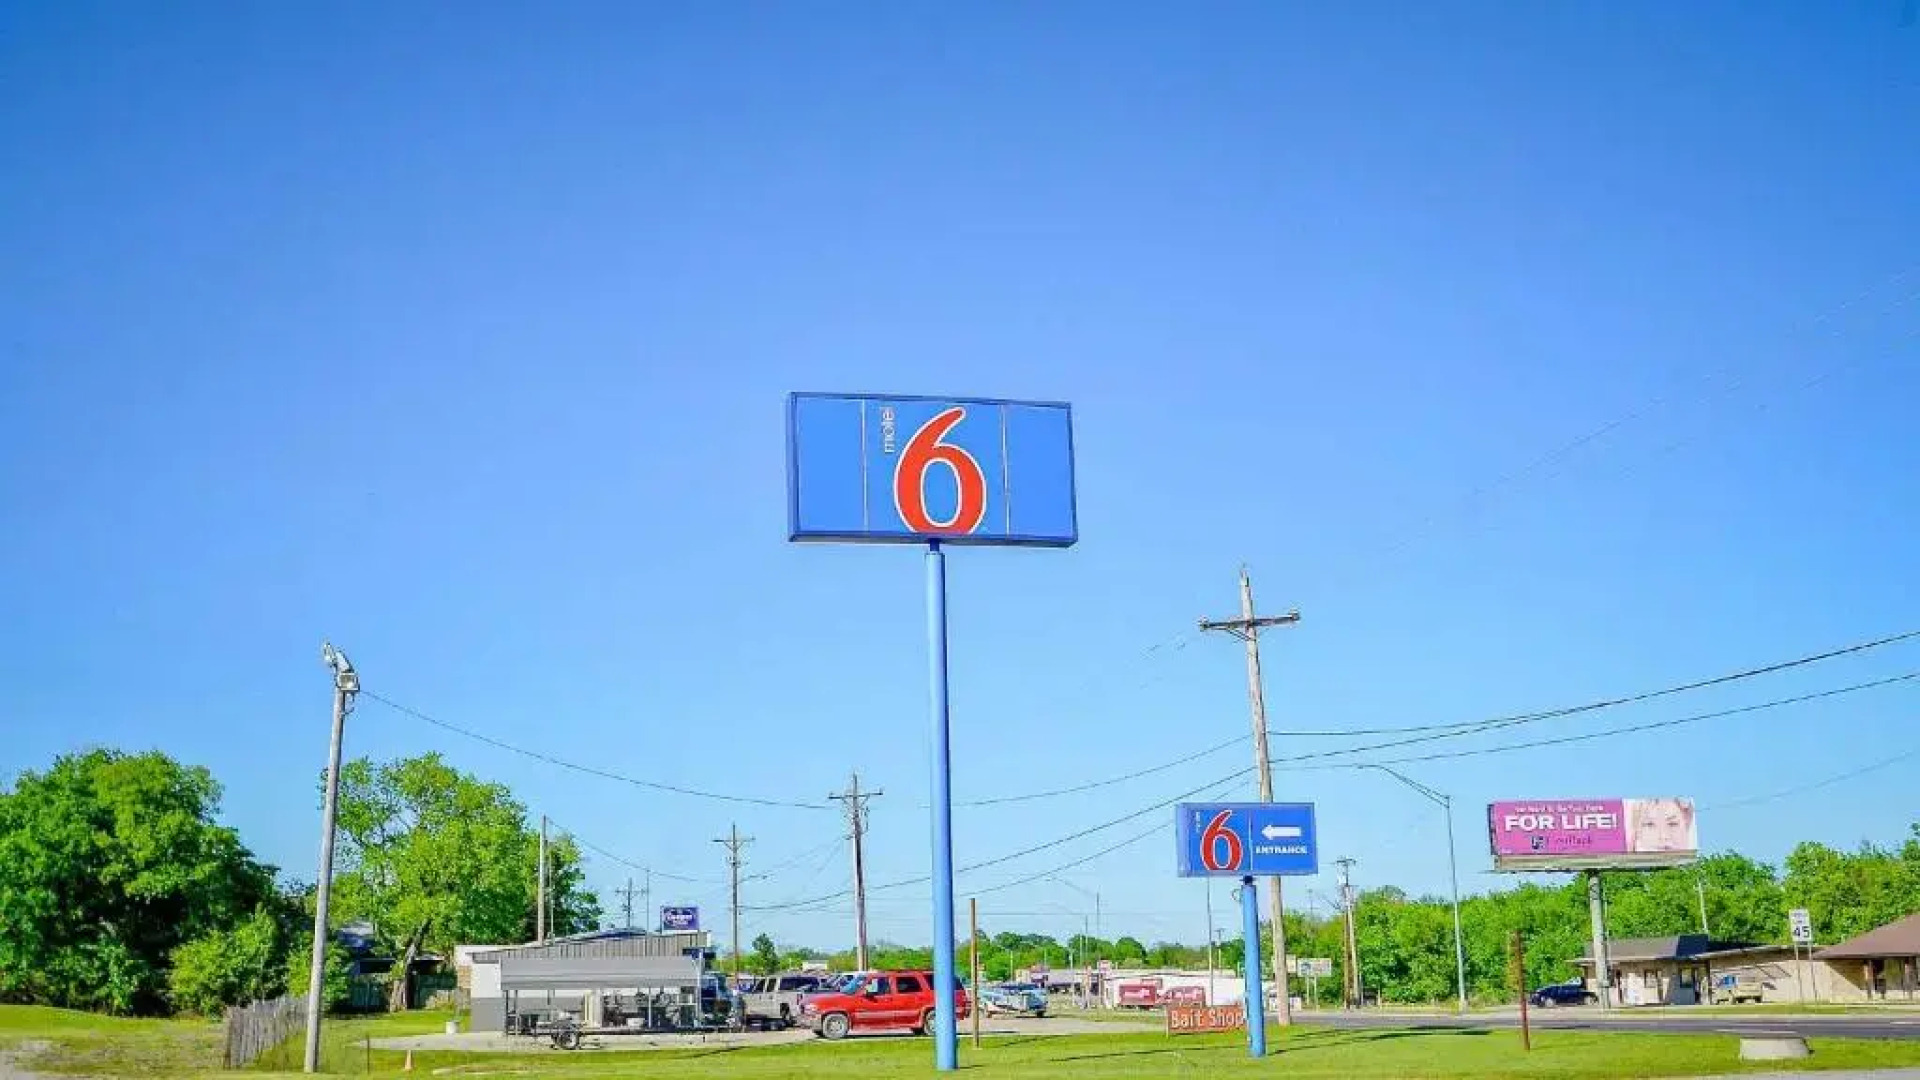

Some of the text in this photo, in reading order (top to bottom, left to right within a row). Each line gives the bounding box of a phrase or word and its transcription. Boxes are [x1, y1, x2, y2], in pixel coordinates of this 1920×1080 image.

[893, 406, 986, 534] 6
[1504, 813, 1617, 831] FOR LIFE!
[1200, 809, 1243, 871] 6
[1793, 925, 1810, 938] 45
[1171, 1008, 1243, 1028] Bait Shop
